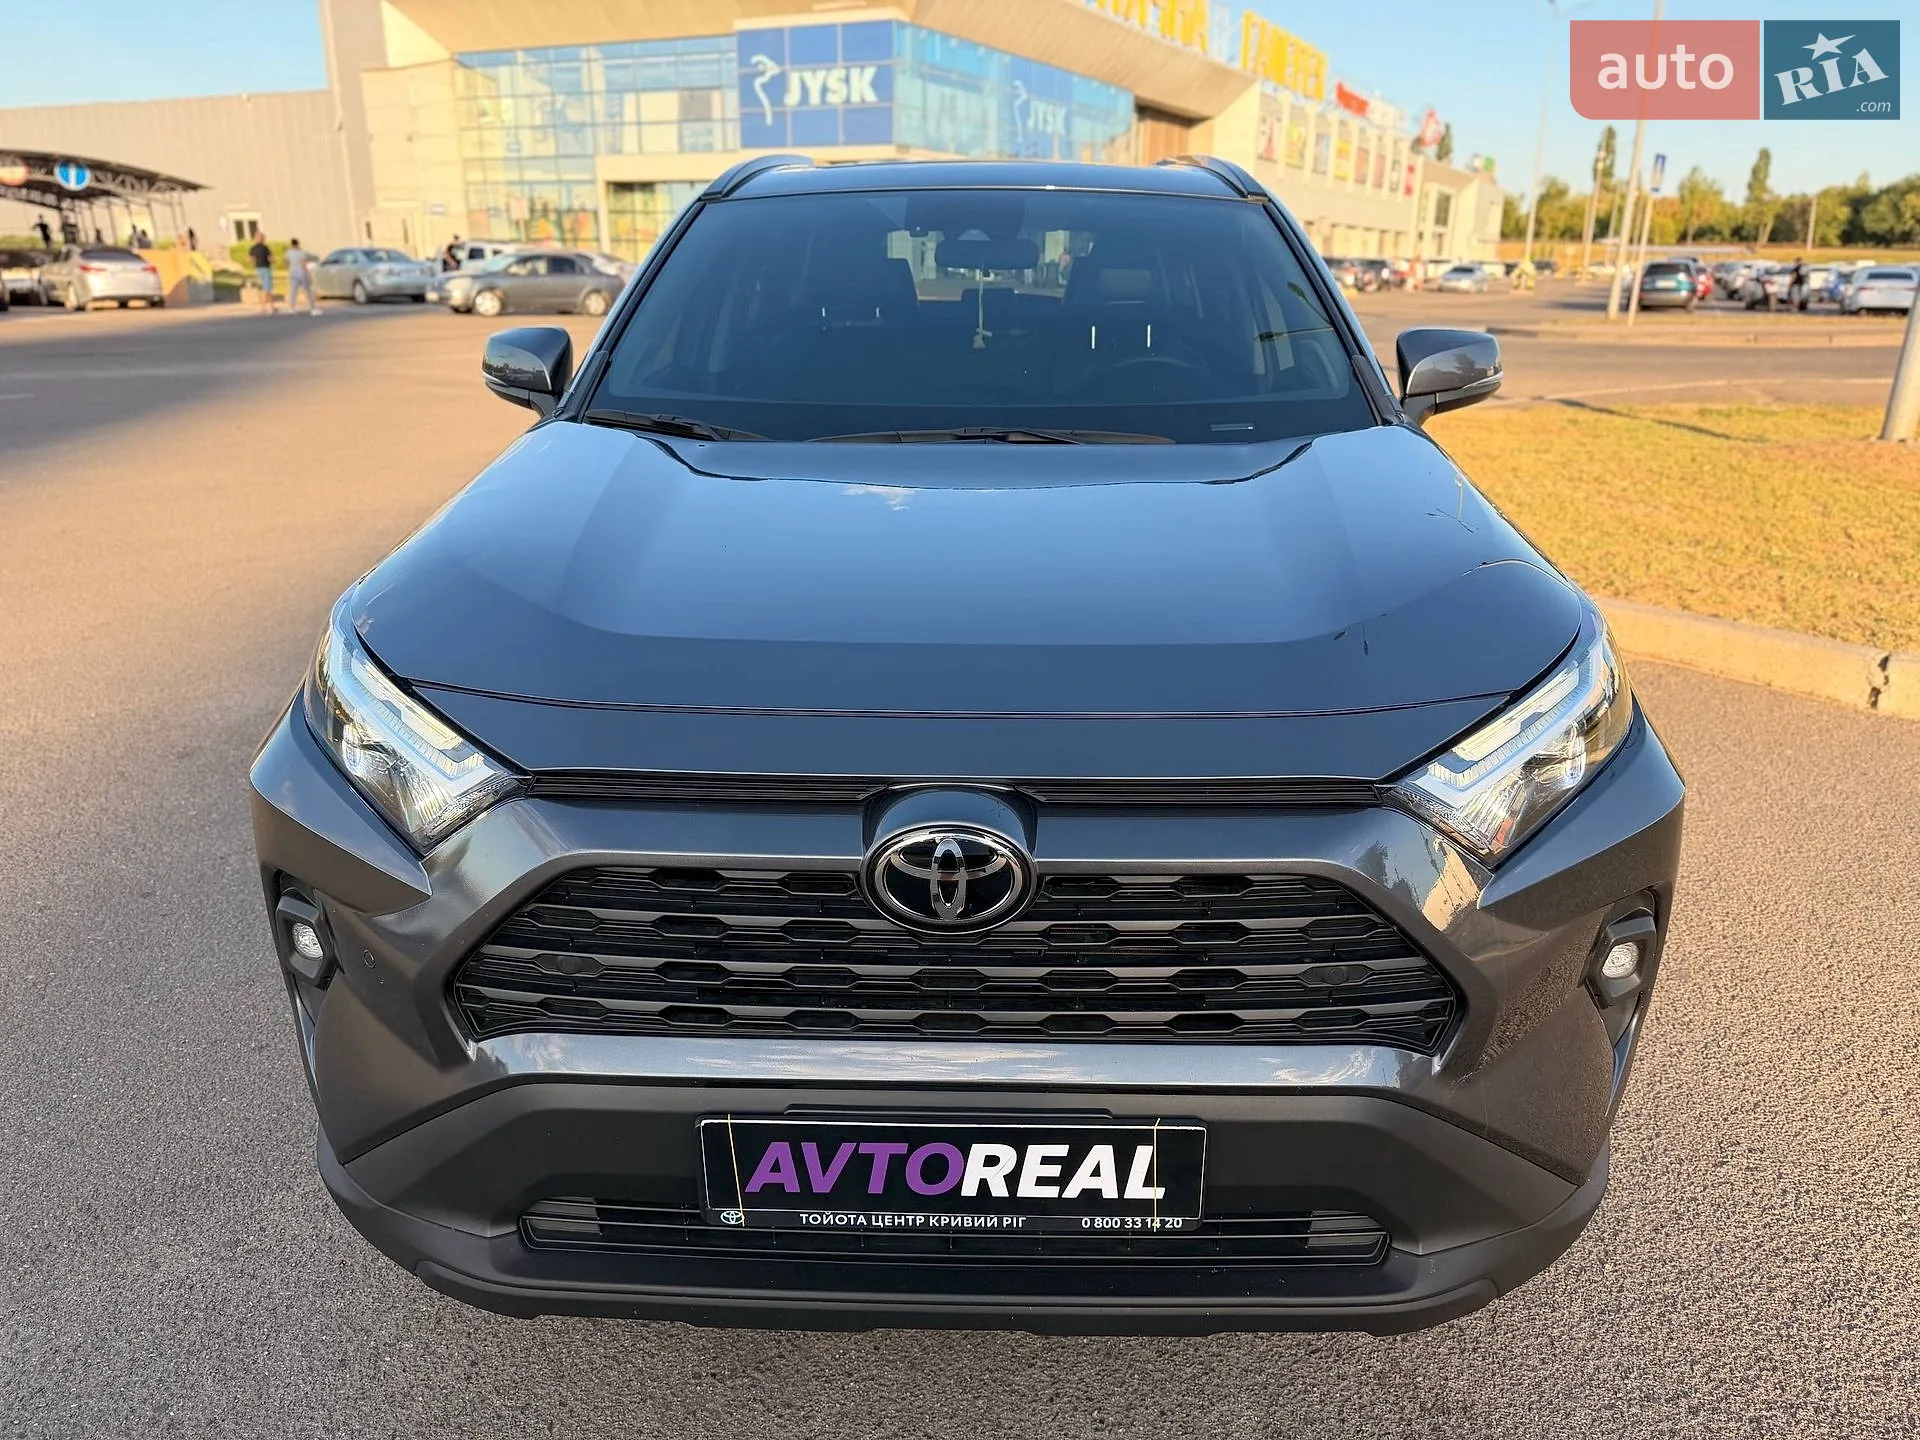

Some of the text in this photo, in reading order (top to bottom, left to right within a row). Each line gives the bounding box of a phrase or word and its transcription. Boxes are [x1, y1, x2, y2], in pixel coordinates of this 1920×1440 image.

[784, 66, 878, 106] JYSK
[1027, 100, 1066, 136] JYSK
[744, 1141, 1167, 1200] AVTOREAL
[799, 1211, 1027, 1228] ТОЙОТА ЦЕНТР КРИВИЙ РІГ
[1081, 1217, 1183, 1229] 0 800 33 14 20
